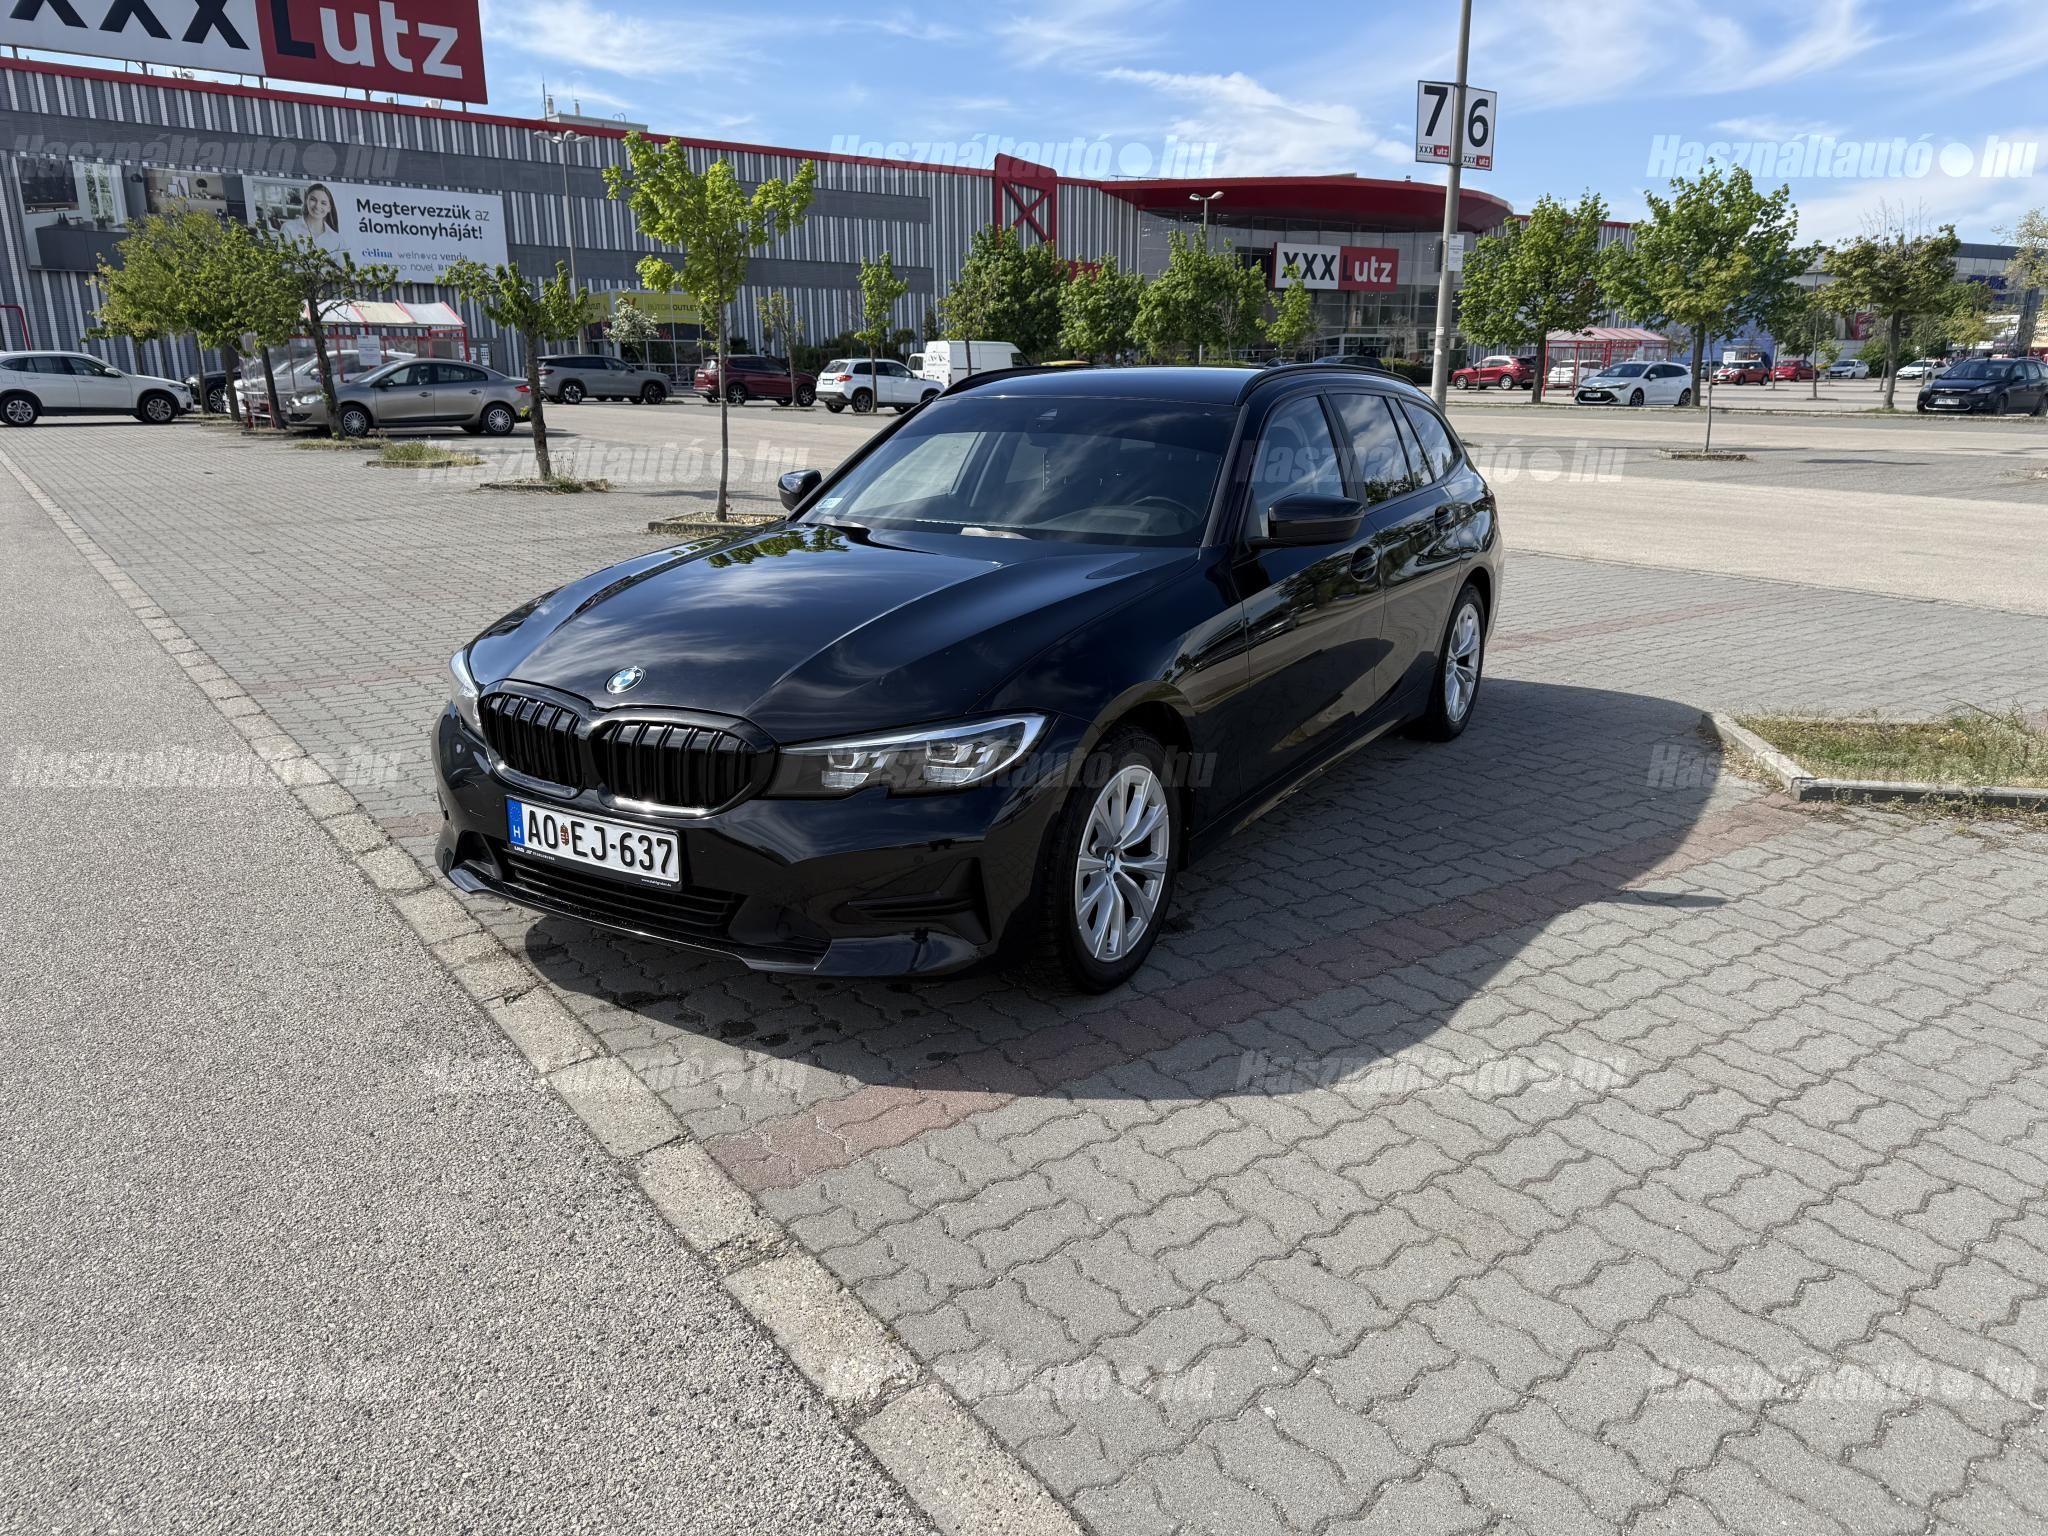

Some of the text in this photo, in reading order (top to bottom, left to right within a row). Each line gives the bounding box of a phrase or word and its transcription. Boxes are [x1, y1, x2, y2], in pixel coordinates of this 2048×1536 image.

[1424, 84, 1448, 137] 7
[1467, 98, 1489, 148] 6
[356, 198, 490, 221] Megtervezzük az
[359, 217, 483, 241] álomkonyháját!
[1281, 251, 1393, 283] XXXLutz
[513, 825, 522, 839] H
[528, 809, 673, 874] AO EJ-637
